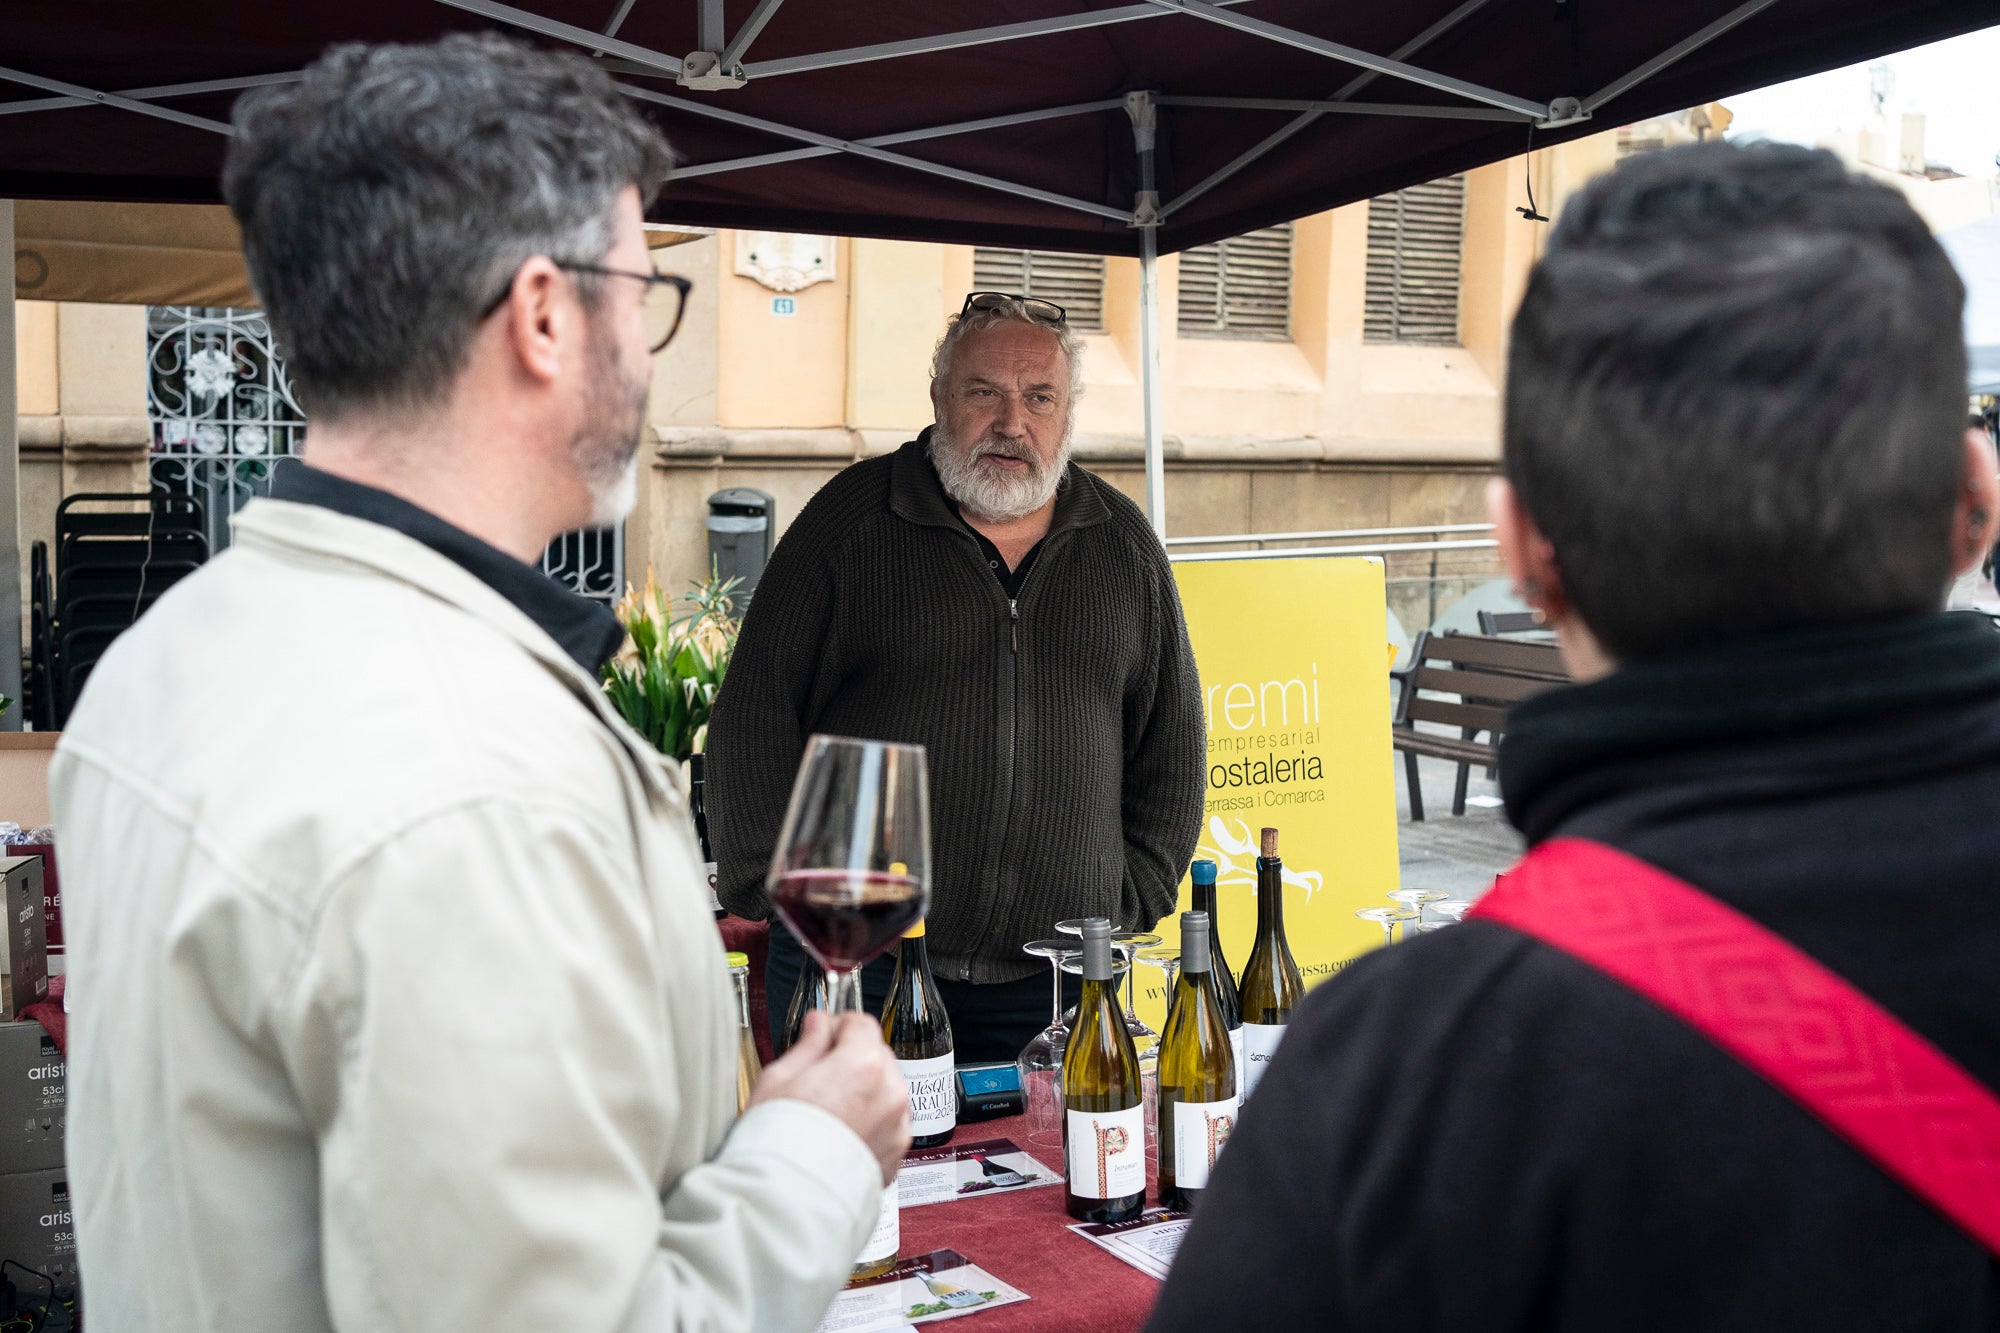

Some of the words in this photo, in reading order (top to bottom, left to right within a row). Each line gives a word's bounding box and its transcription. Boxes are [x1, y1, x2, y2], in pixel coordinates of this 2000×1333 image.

[1207, 662, 1320, 731] remi
[1206, 728, 1321, 754] empresarial
[1206, 750, 1324, 789] ostaleria
[1264, 789, 1325, 807] Comarca
[20, 904, 34, 923] aristo
[42, 1085, 65, 1095] 53cl
[937, 1147, 987, 1159] Terrassa
[54, 1232, 76, 1242] 53cl
